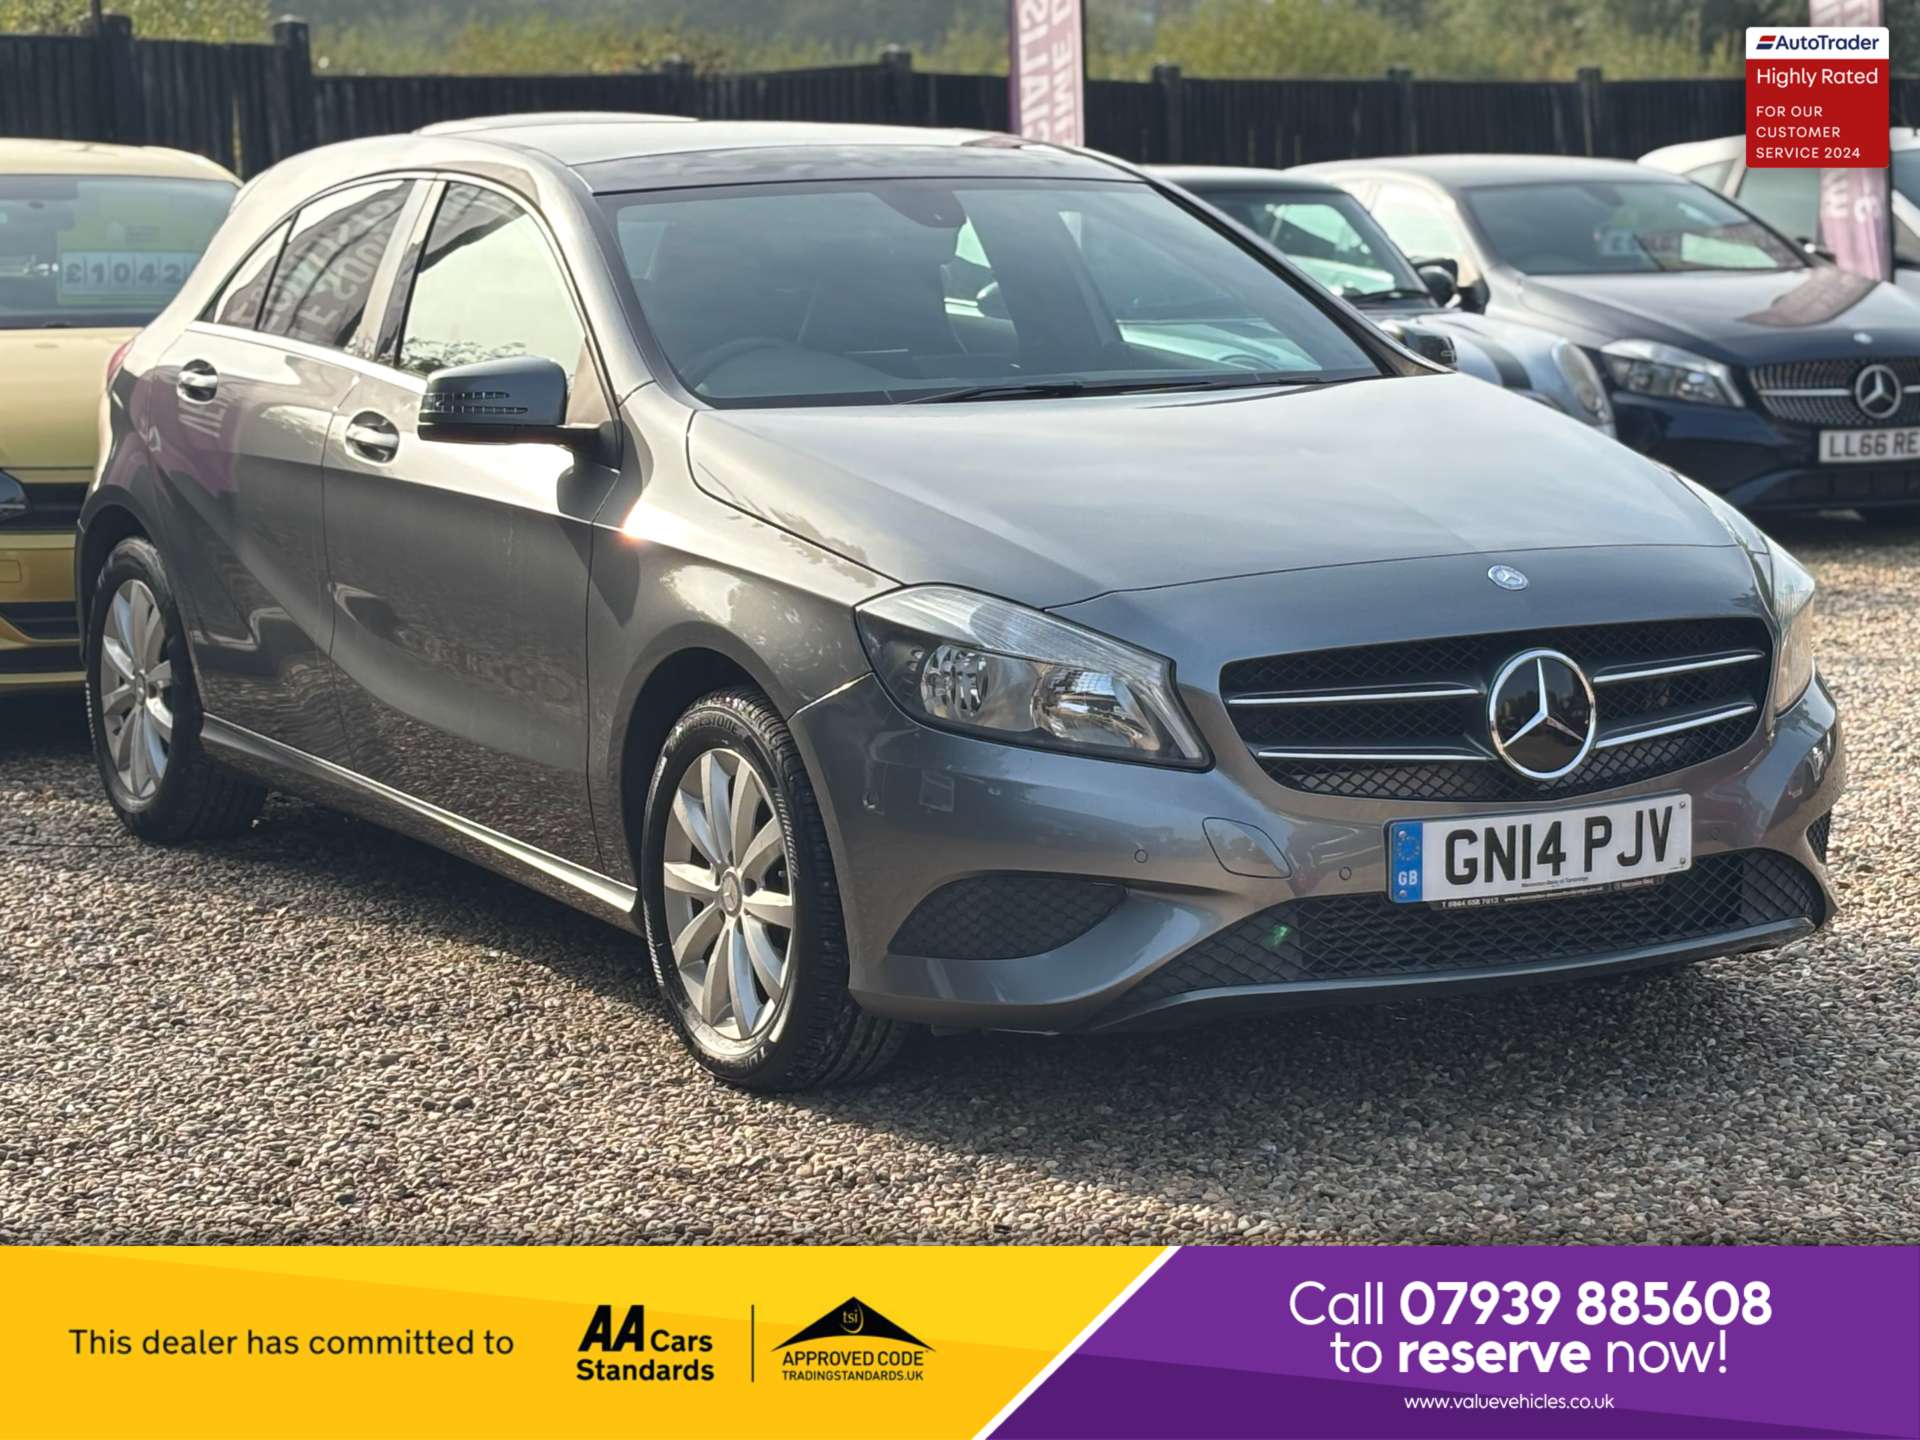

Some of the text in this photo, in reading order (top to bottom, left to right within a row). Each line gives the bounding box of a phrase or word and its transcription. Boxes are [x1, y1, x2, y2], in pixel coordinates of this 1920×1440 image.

[1829, 433, 1888, 458] LL66
[1445, 805, 1673, 886] GN14 PJV
[1398, 869, 1418, 887] GB
